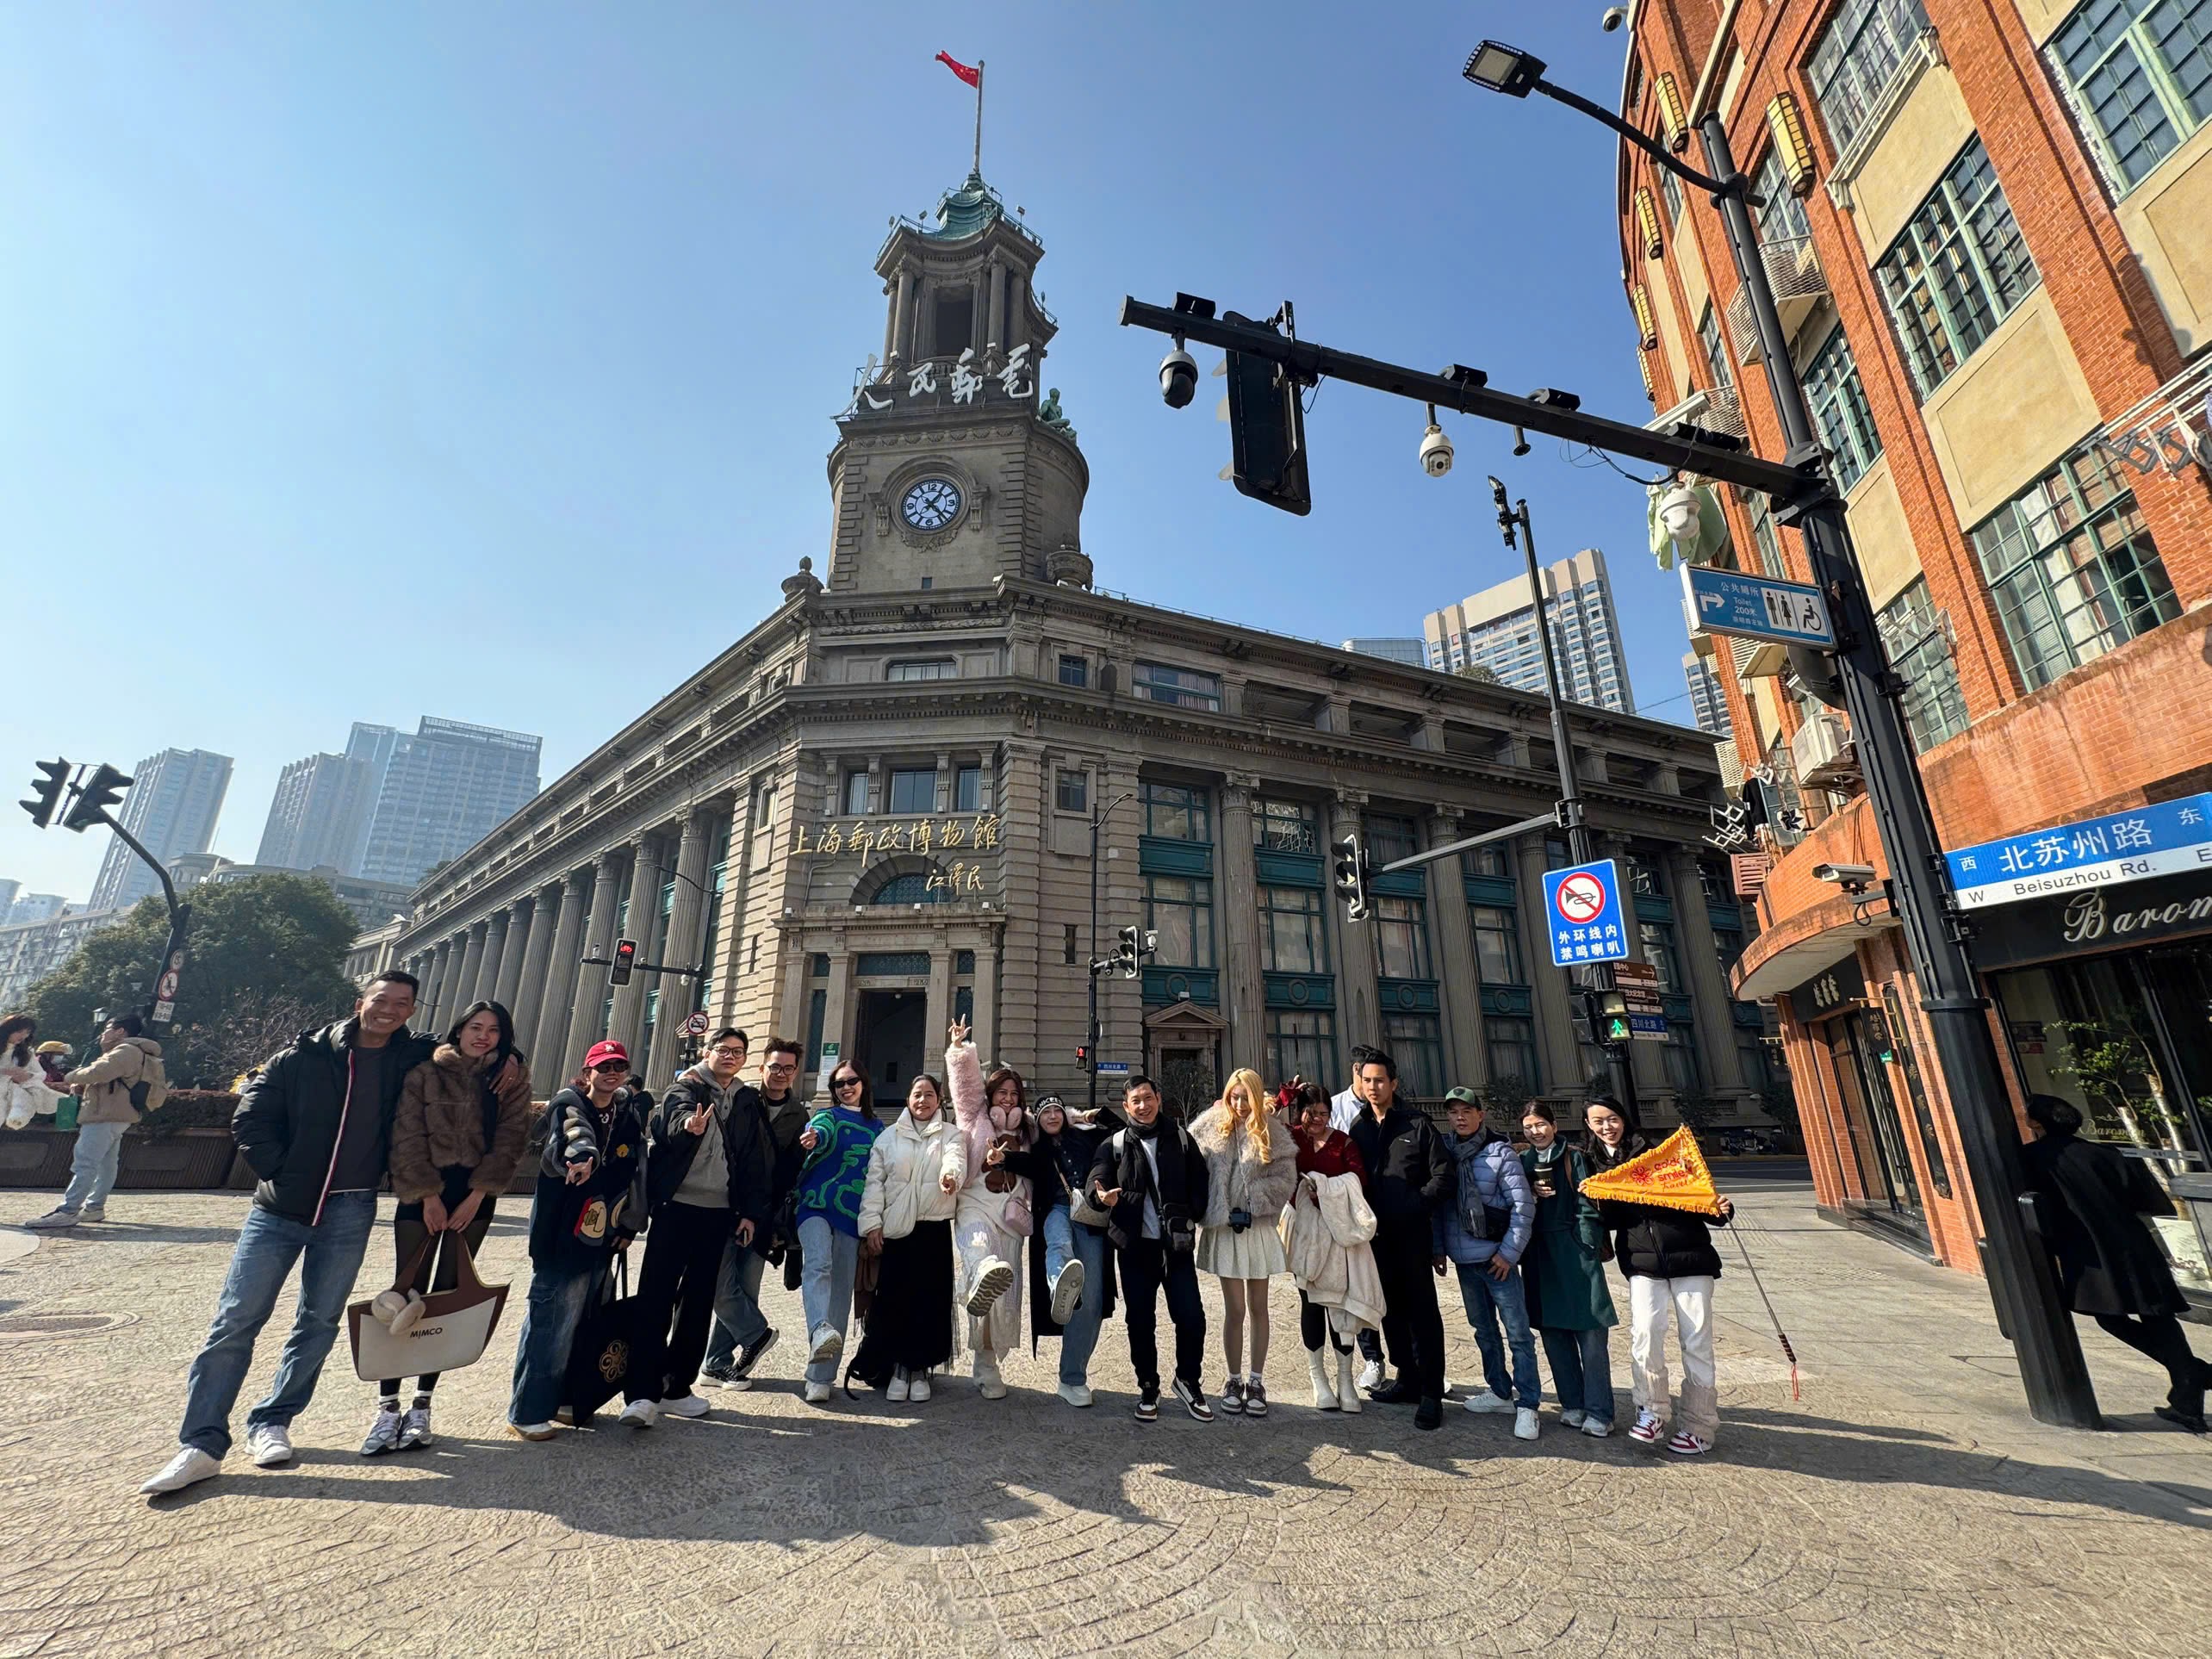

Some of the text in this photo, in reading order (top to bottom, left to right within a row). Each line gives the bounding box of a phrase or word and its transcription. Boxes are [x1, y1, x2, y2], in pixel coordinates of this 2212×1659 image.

[1732, 596, 1753, 606] Toilet
[1958, 807, 2204, 873] 西 北苏州路 东
[1967, 848, 2212, 904] W Beisuzhou Rd. E
[1558, 923, 1618, 945] 外环线内
[1560, 940, 1621, 961] 禁鸣喇叭
[409, 1327, 444, 1339] MIMCO
